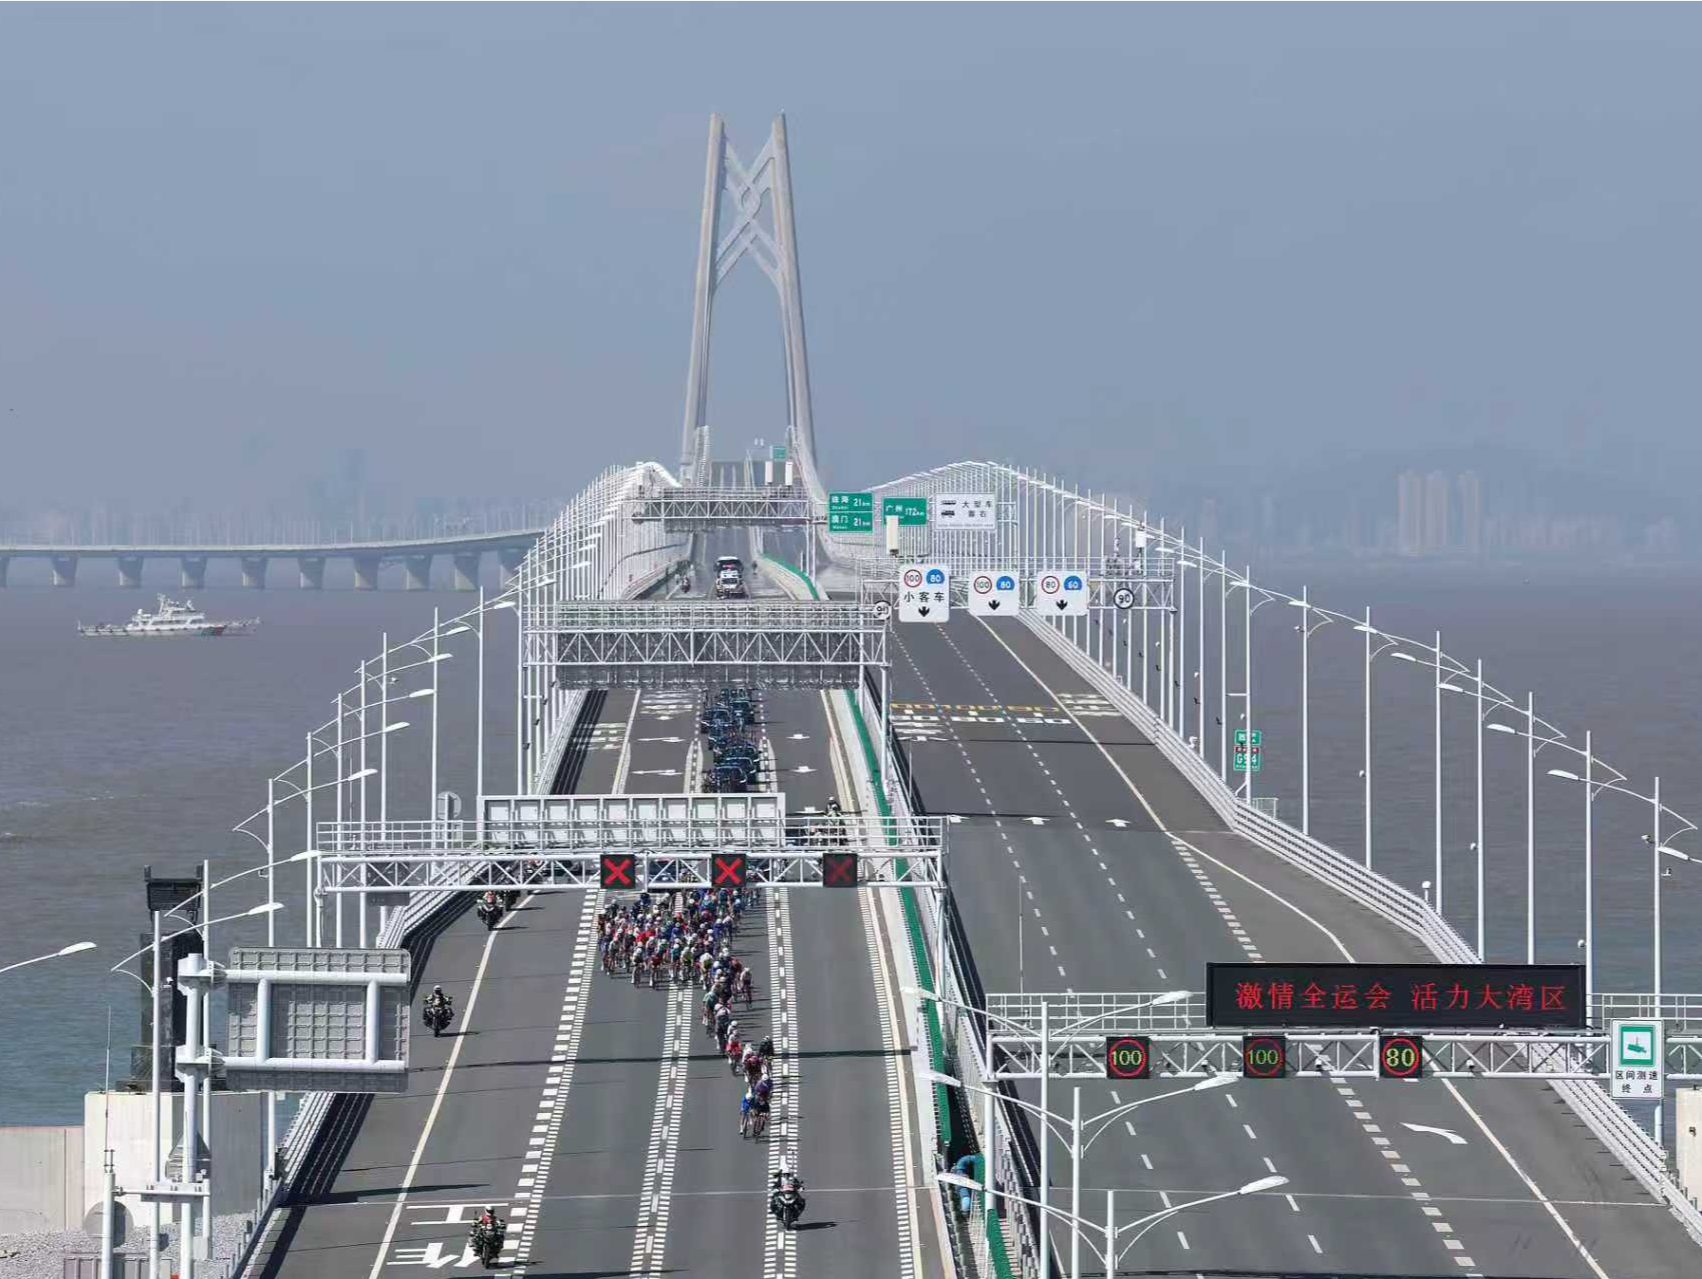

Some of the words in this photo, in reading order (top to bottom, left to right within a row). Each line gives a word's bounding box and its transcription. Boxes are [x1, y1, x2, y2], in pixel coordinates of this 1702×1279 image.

[906, 574, 920, 582] 100
[929, 574, 941, 582] 80
[976, 581, 990, 589] 100
[1000, 581, 1011, 589] 80
[1045, 581, 1056, 589] 80
[904, 591, 945, 603] 小客车
[1118, 593, 1130, 605] 90
[1235, 982, 1392, 1010] 激情全运会
[1410, 982, 1567, 1010] 活力大湾区
[1111, 1050, 1143, 1066] 100
[1249, 1049, 1278, 1065] 100
[1386, 1048, 1414, 1067] 80
[1615, 1070, 1658, 1080] 区间测速
[1622, 1084, 1653, 1094] 终点
